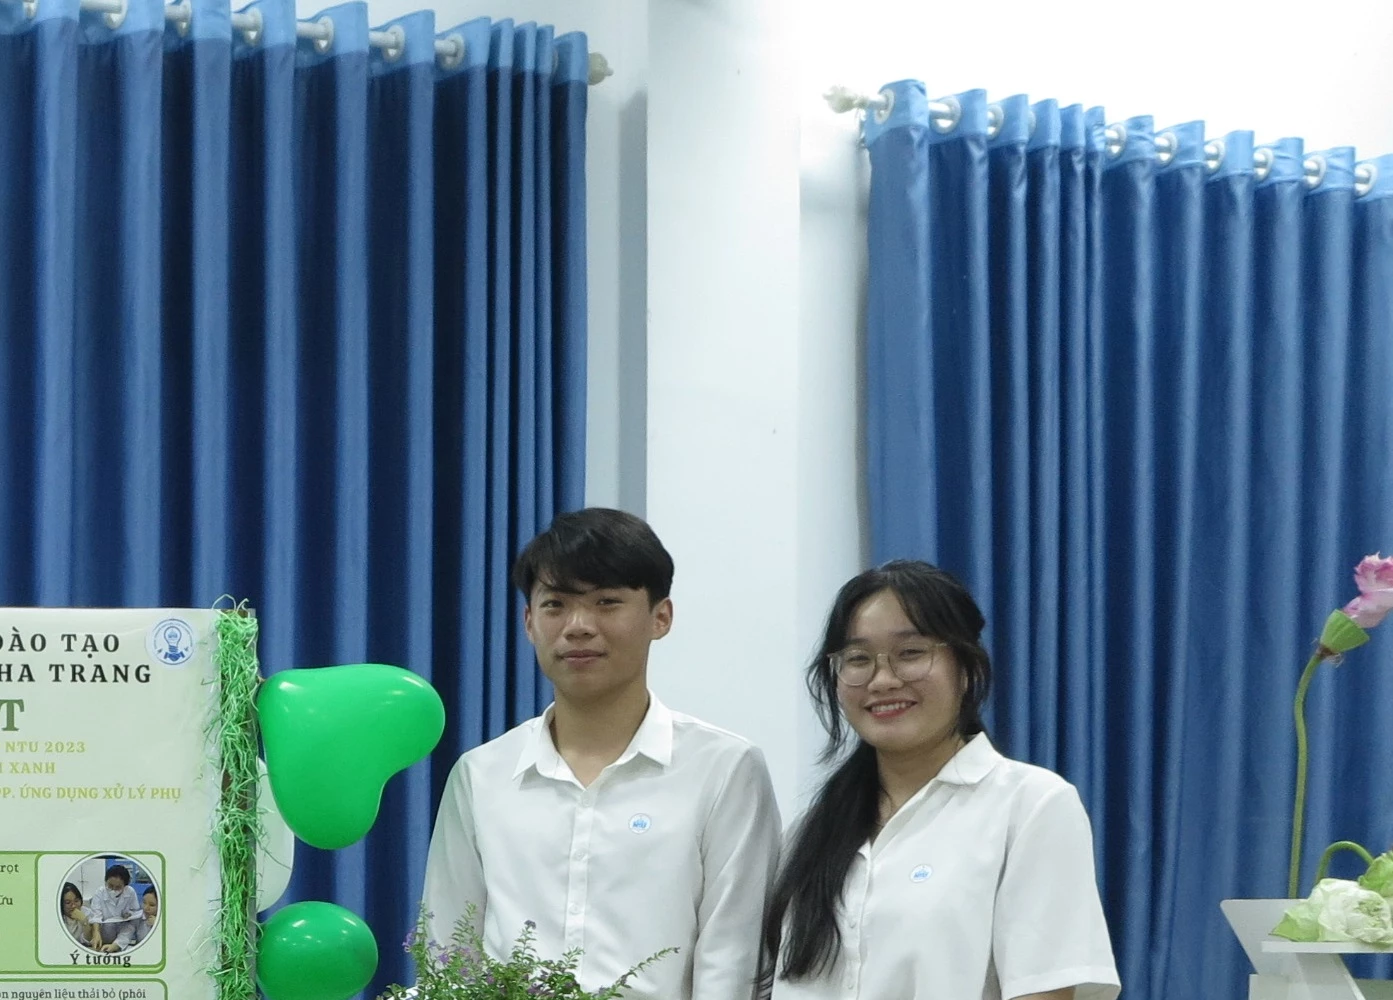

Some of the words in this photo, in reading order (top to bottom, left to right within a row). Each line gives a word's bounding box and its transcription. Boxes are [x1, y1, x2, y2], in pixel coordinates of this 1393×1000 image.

[61, 633, 120, 659] TẠO
[49, 663, 151, 684] TRANG
[5, 741, 39, 753] NTU
[44, 741, 86, 753] 2023
[10, 762, 56, 774] XANH
[20, 784, 52, 799] ỨNG
[57, 787, 98, 802] DỤNG
[128, 784, 146, 799] LÝ
[151, 787, 181, 803] PHỤ
[69, 948, 80, 965] Ý
[11, 988, 52, 1000] nguyên
[54, 988, 75, 1000] liệu
[118, 988, 146, 1000] (phôi
